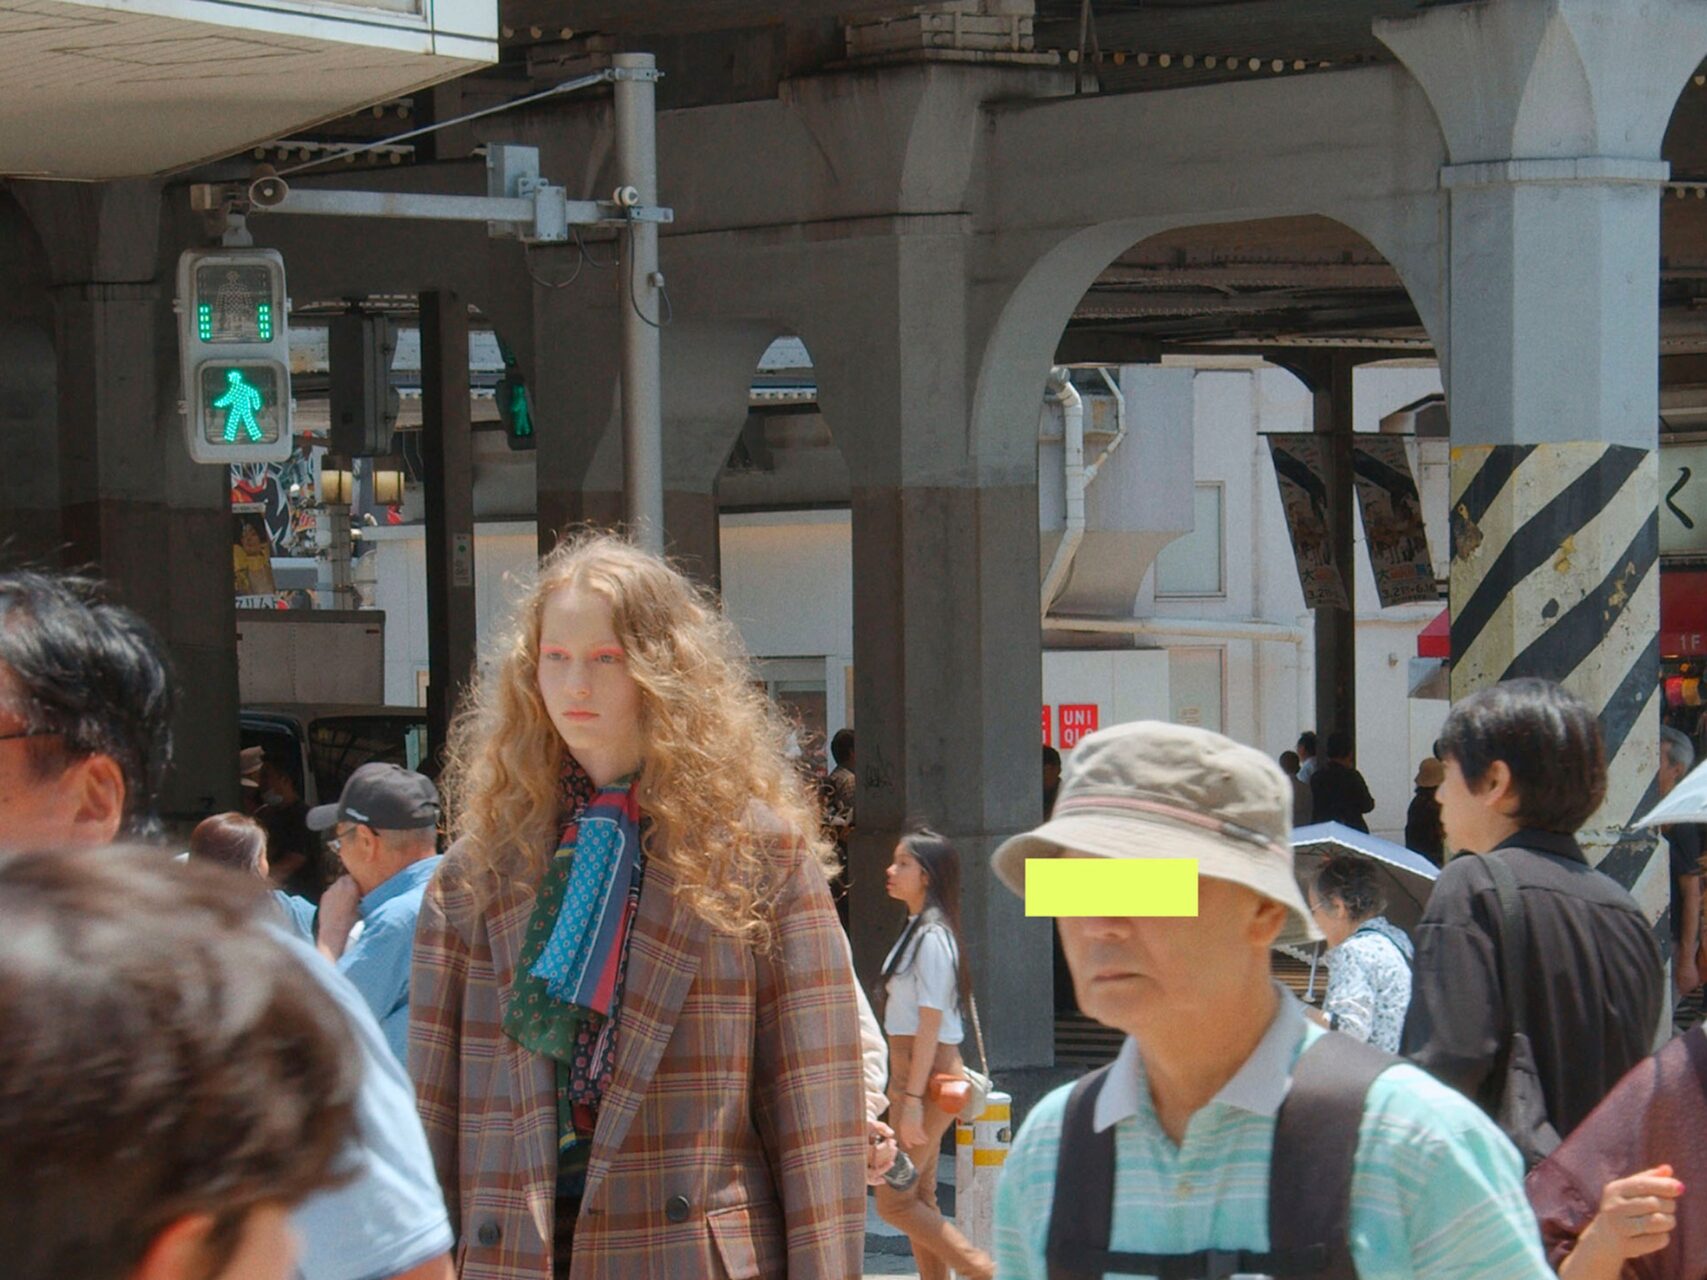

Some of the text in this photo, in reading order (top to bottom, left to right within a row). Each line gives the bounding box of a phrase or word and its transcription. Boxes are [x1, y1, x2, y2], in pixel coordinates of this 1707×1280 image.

[1665, 466, 1694, 530] く
[1680, 634, 1701, 651] 1F
[1063, 710, 1092, 725] UNI
